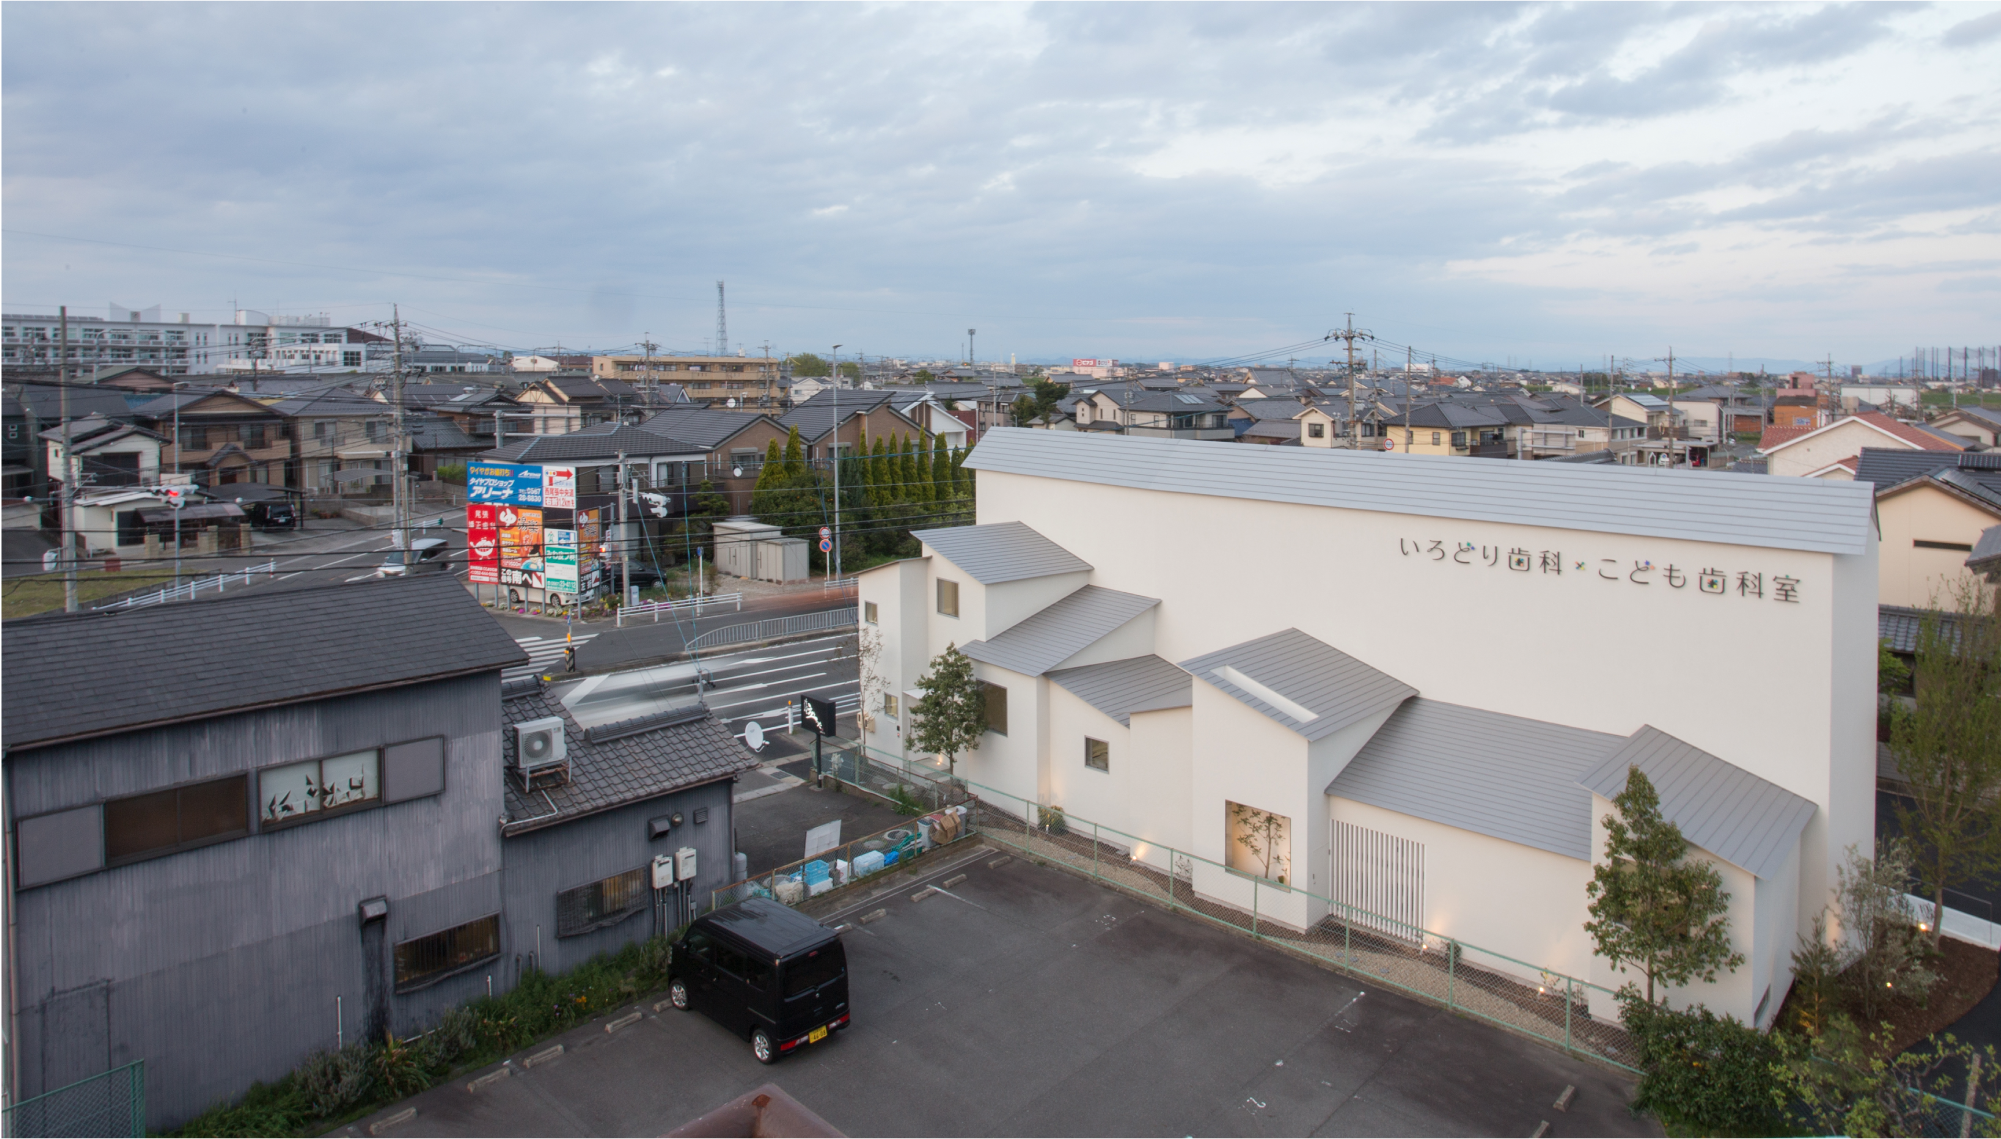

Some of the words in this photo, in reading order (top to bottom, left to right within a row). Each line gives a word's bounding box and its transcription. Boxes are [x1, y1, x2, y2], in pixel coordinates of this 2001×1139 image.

[469, 477, 515, 487] タイヤプロショップ
[469, 486, 514, 500] アリーナ
